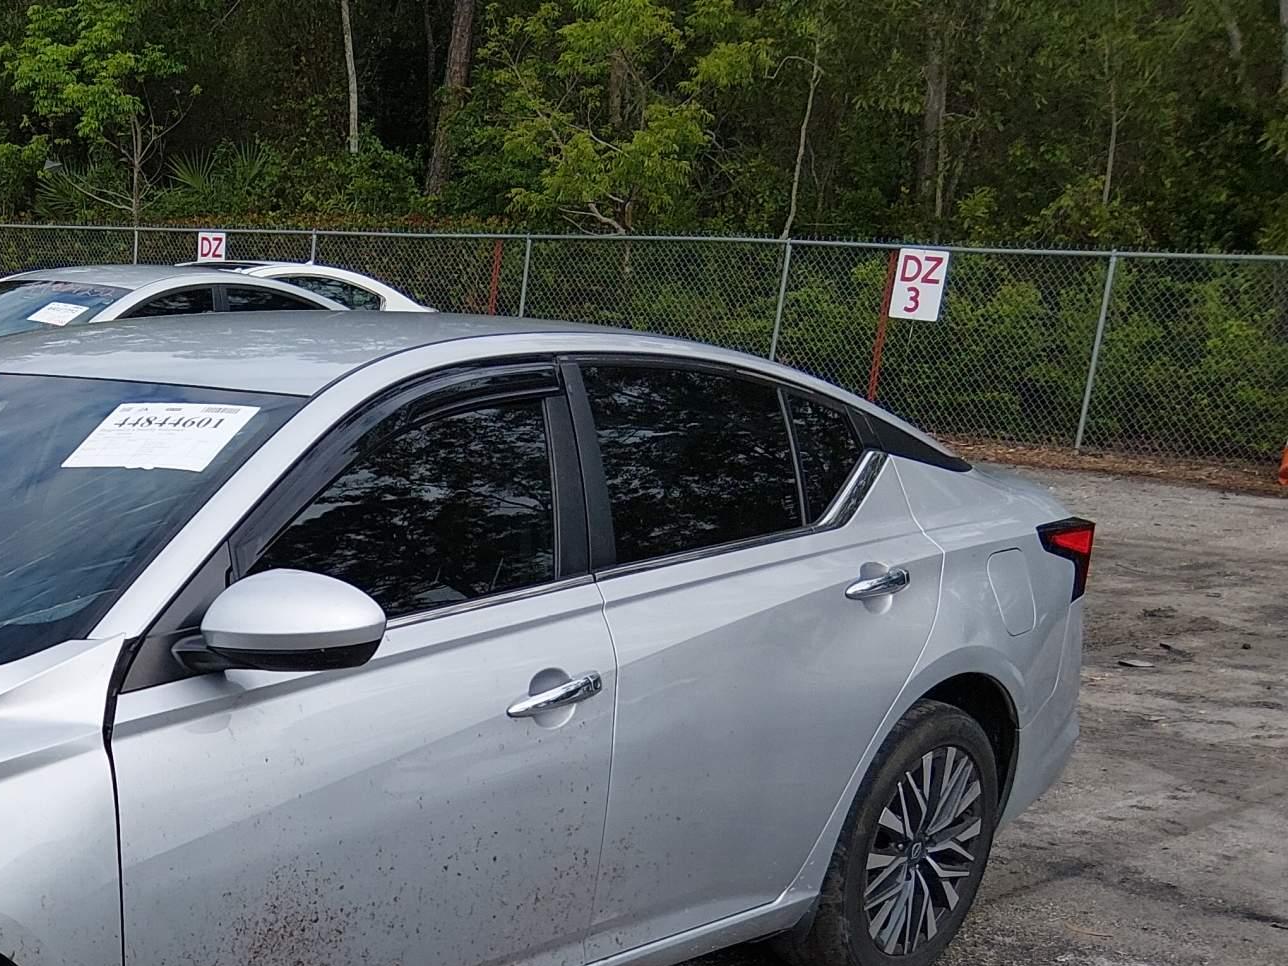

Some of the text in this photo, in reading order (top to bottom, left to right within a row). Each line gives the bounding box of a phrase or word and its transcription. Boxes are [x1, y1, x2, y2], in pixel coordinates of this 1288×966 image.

[201, 237, 222, 257] DZ
[900, 255, 943, 284] DZ
[903, 287, 920, 312] 3
[114, 416, 224, 429] 44844601
